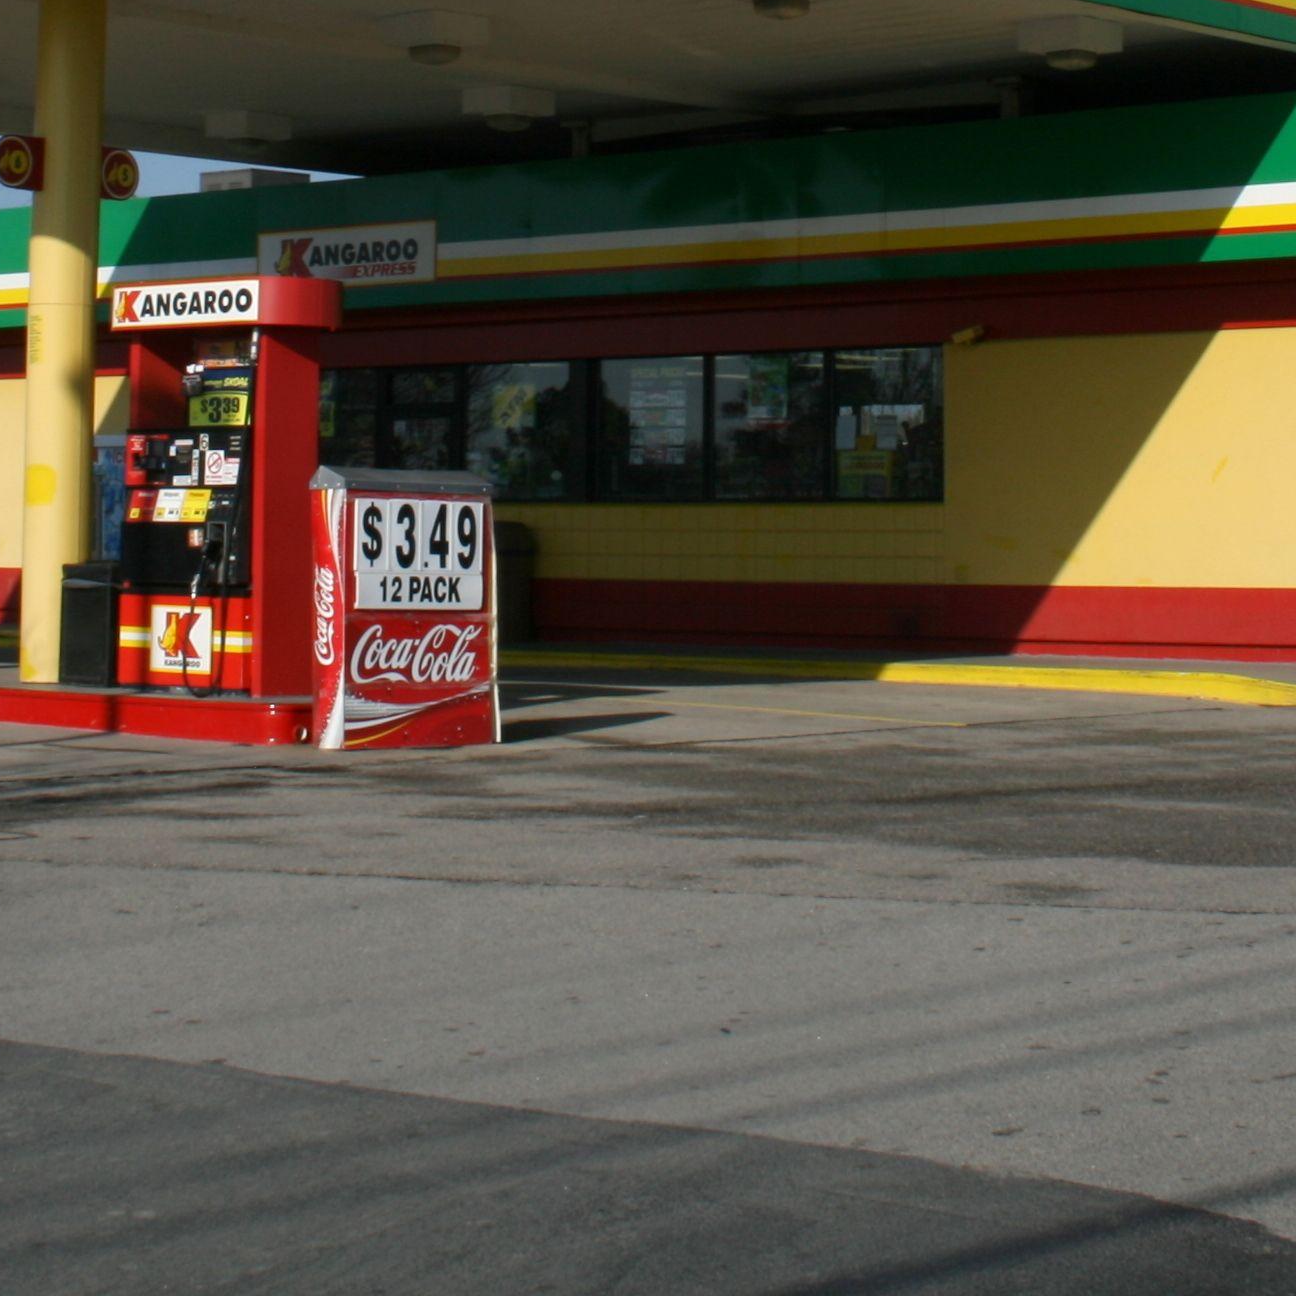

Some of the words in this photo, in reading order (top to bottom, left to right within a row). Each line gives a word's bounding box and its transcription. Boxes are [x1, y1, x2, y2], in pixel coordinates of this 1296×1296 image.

[275, 237, 418, 277] KANGAROO
[354, 262, 416, 278] EXPRESS
[115, 288, 253, 323] KANGAROO
[361, 501, 478, 570] $3.49
[379, 576, 403, 603] 12
[408, 576, 462, 604] PACK
[350, 622, 482, 684] Coca-Cola
